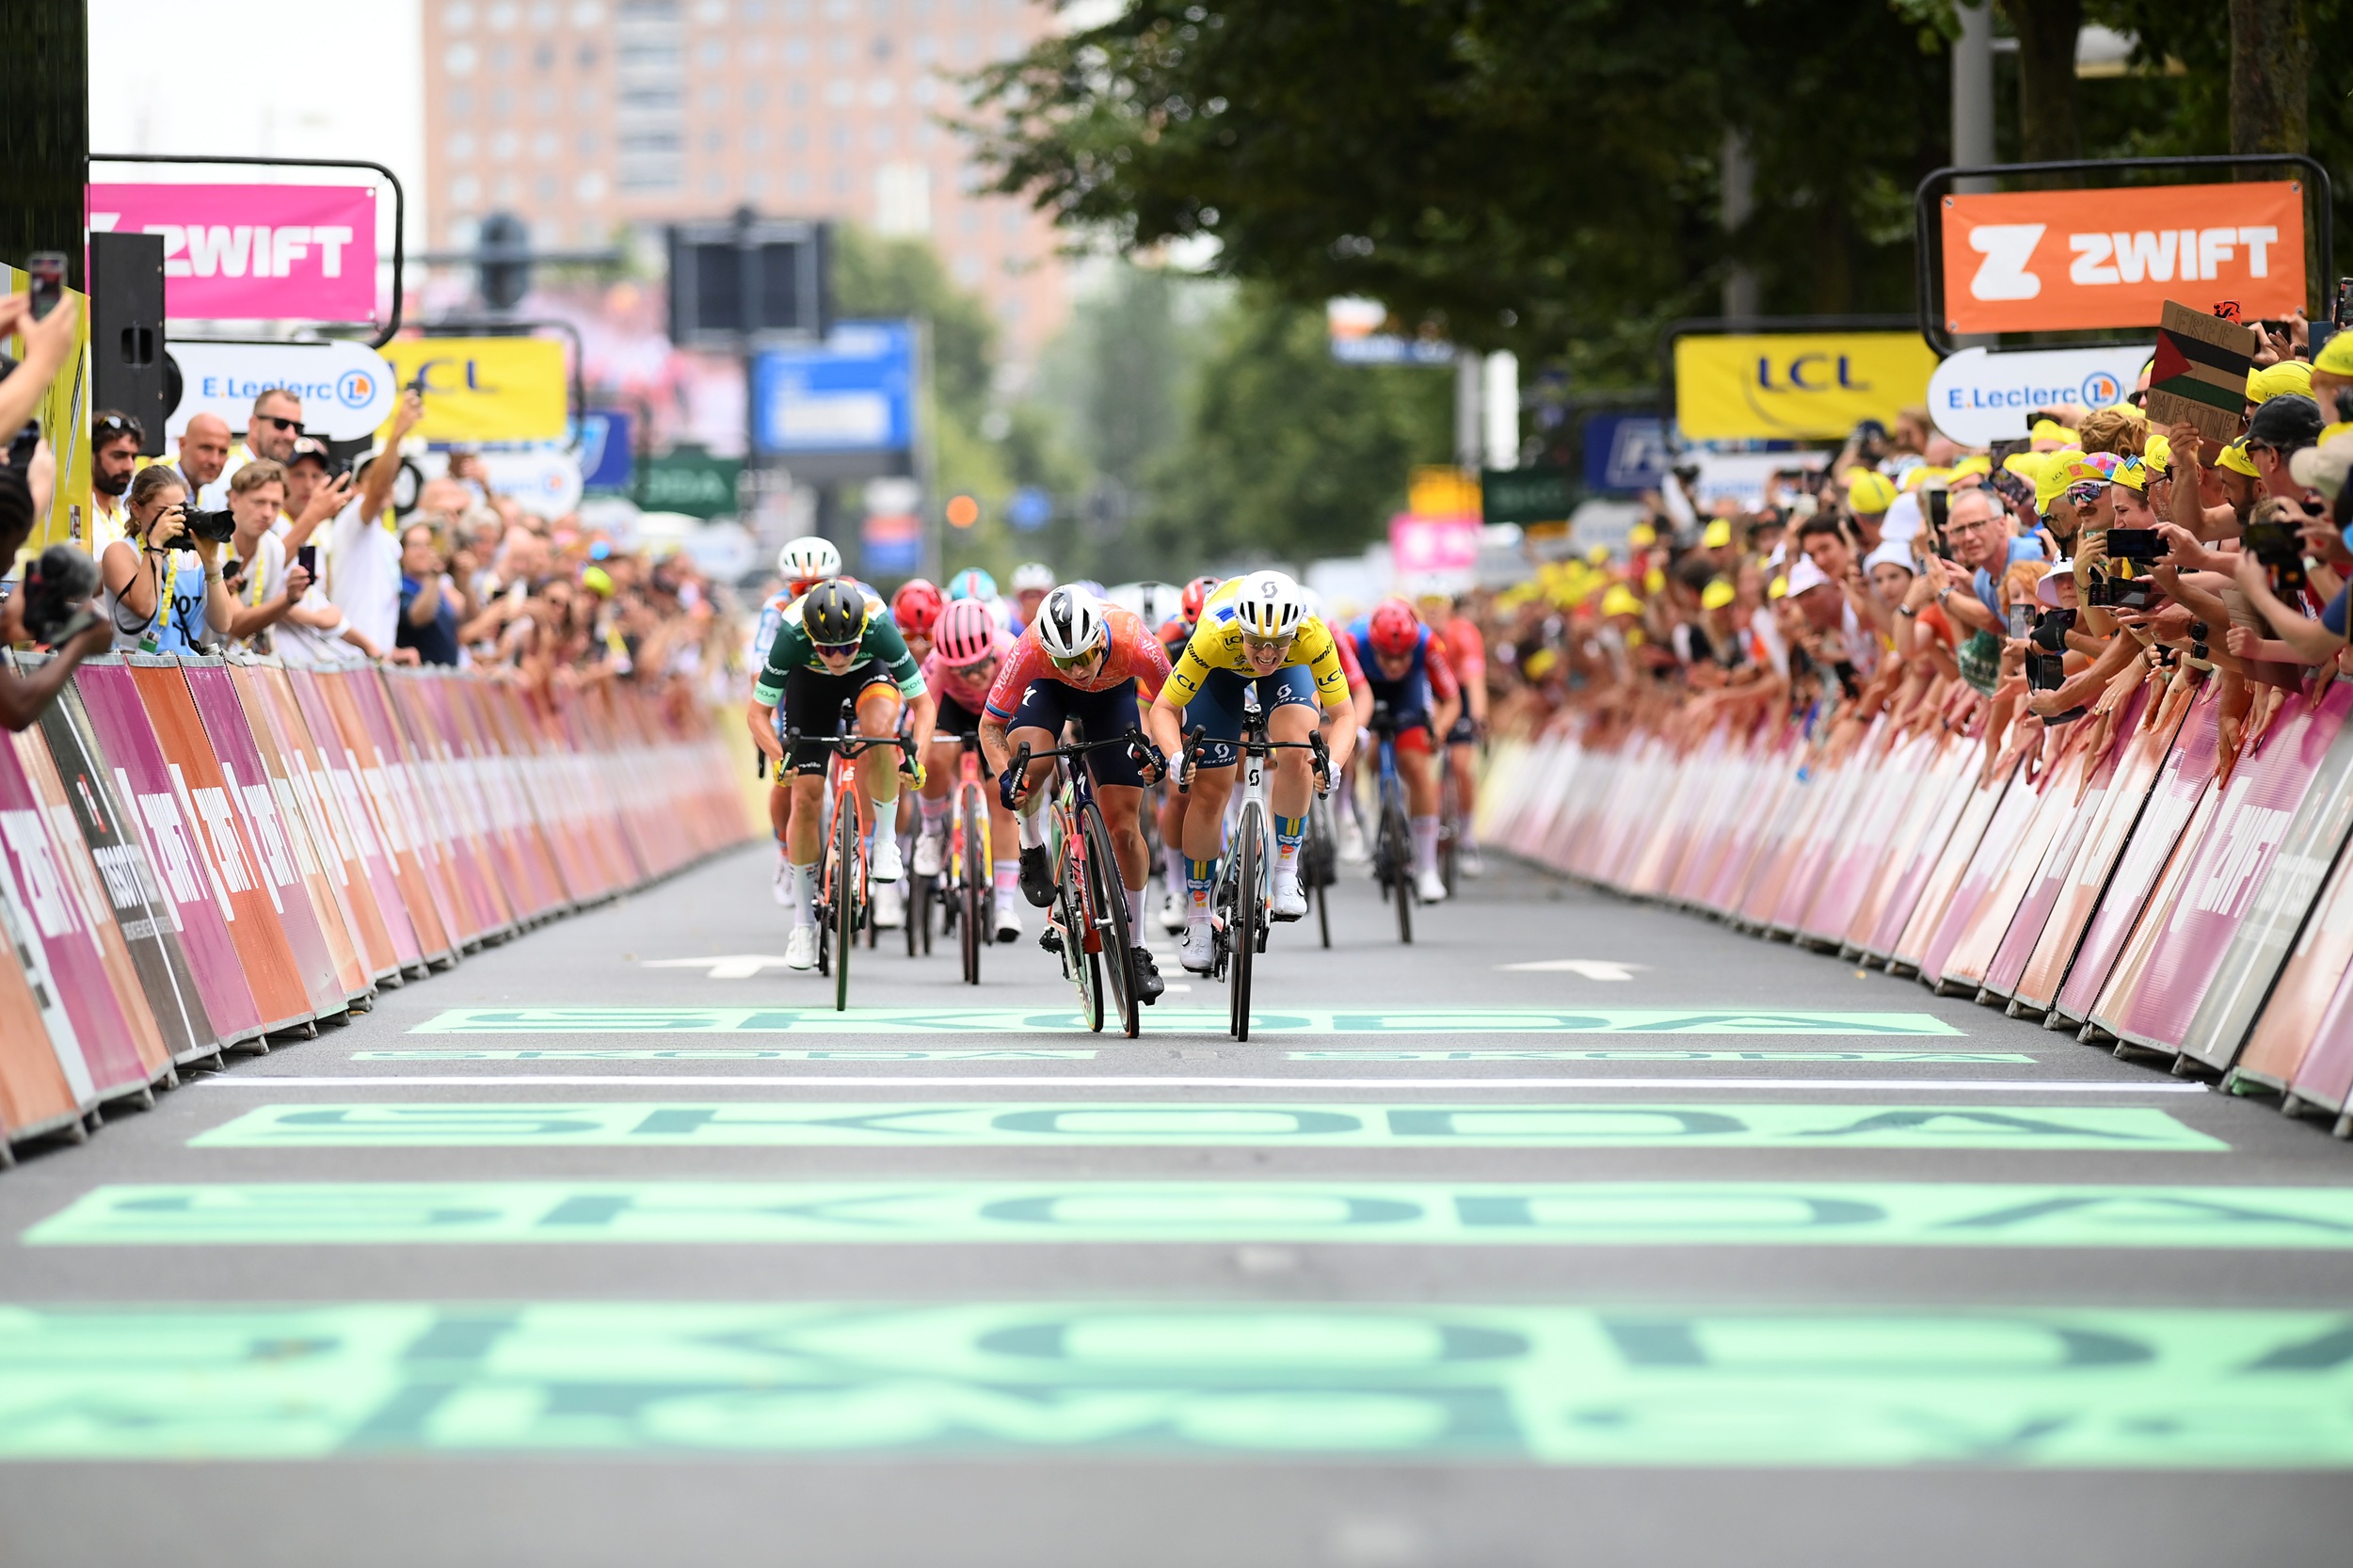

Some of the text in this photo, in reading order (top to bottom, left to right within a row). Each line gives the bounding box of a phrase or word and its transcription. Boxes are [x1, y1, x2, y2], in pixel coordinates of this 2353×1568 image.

[142, 223, 354, 279] ZWIFT
[2069, 225, 2279, 286] ZWIFT
[2175, 309, 2234, 352] FREE
[387, 358, 500, 393] CL
[1757, 354, 1872, 393] LCL
[1948, 385, 2078, 409] E.Leclerc
[2148, 390, 2236, 445] PALESTINE
[1172, 666, 1198, 693] LCL
[1202, 755, 1238, 765] SCOTT
[367, 1050, 1080, 1061] SKODA
[1305, 1050, 2016, 1063] SKODA
[259, 1108, 2178, 1141] SKODA
